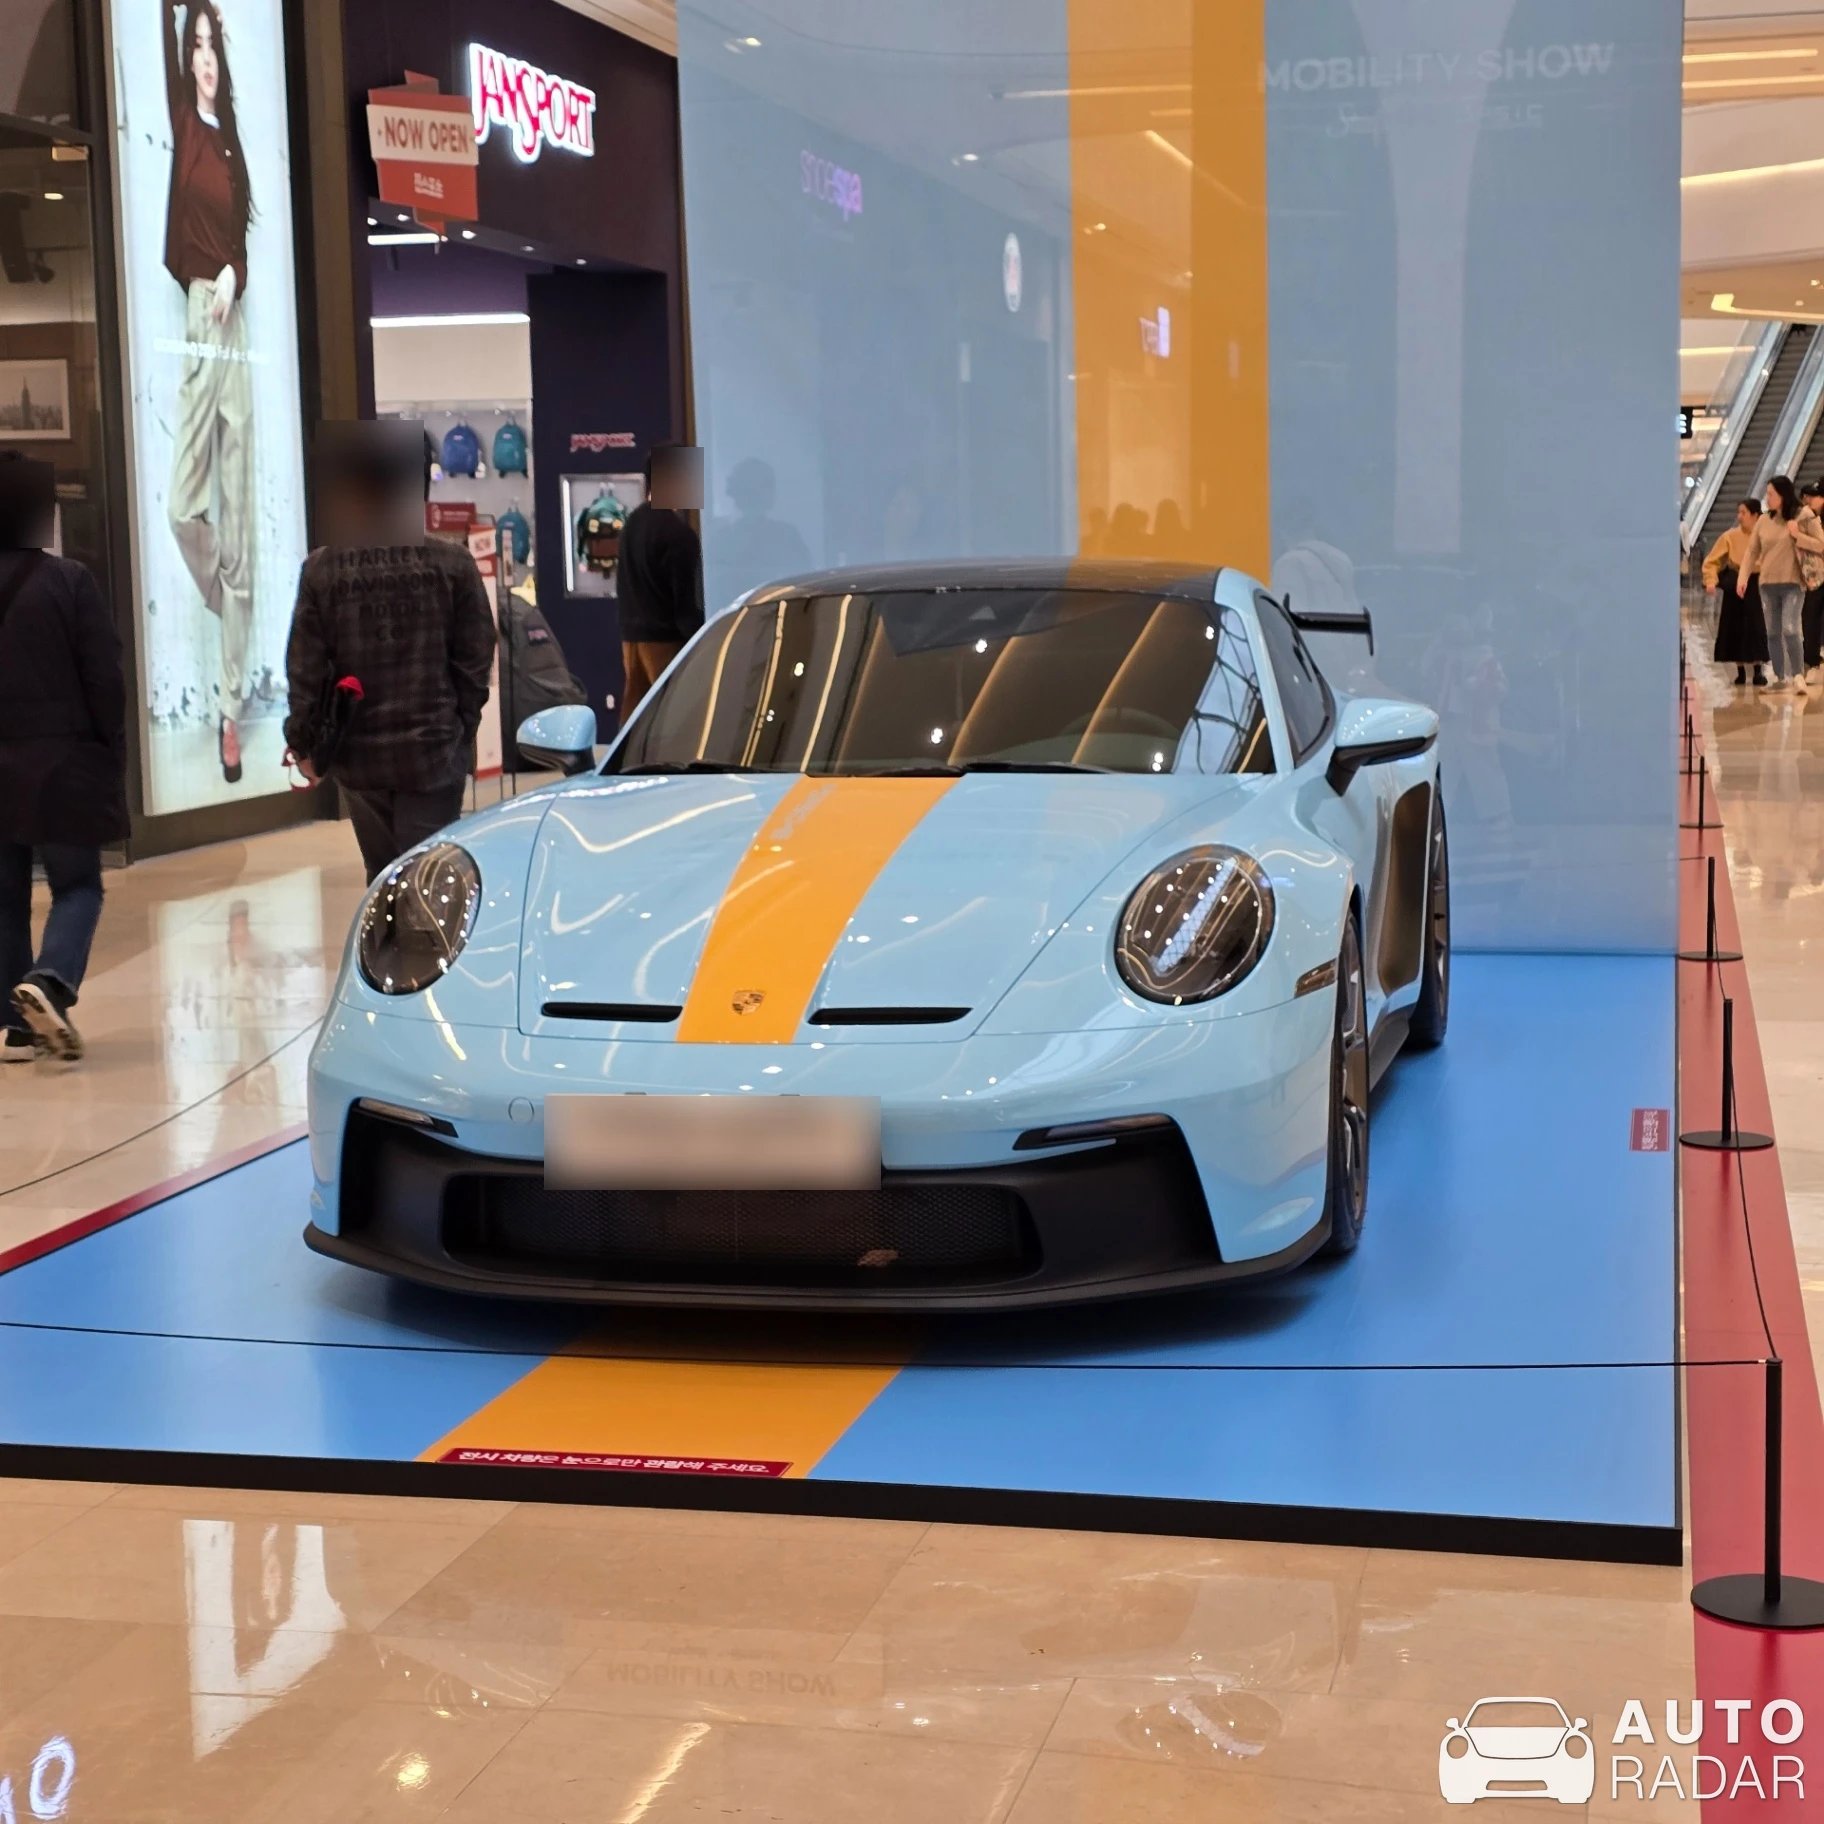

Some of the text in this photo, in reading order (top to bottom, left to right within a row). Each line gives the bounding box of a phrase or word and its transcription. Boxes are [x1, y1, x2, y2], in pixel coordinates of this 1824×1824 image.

[1257, 41, 1615, 94] MOBILITY SHOW
[469, 44, 595, 162] JANSPORT
[384, 116, 470, 153] NOW OPEN
